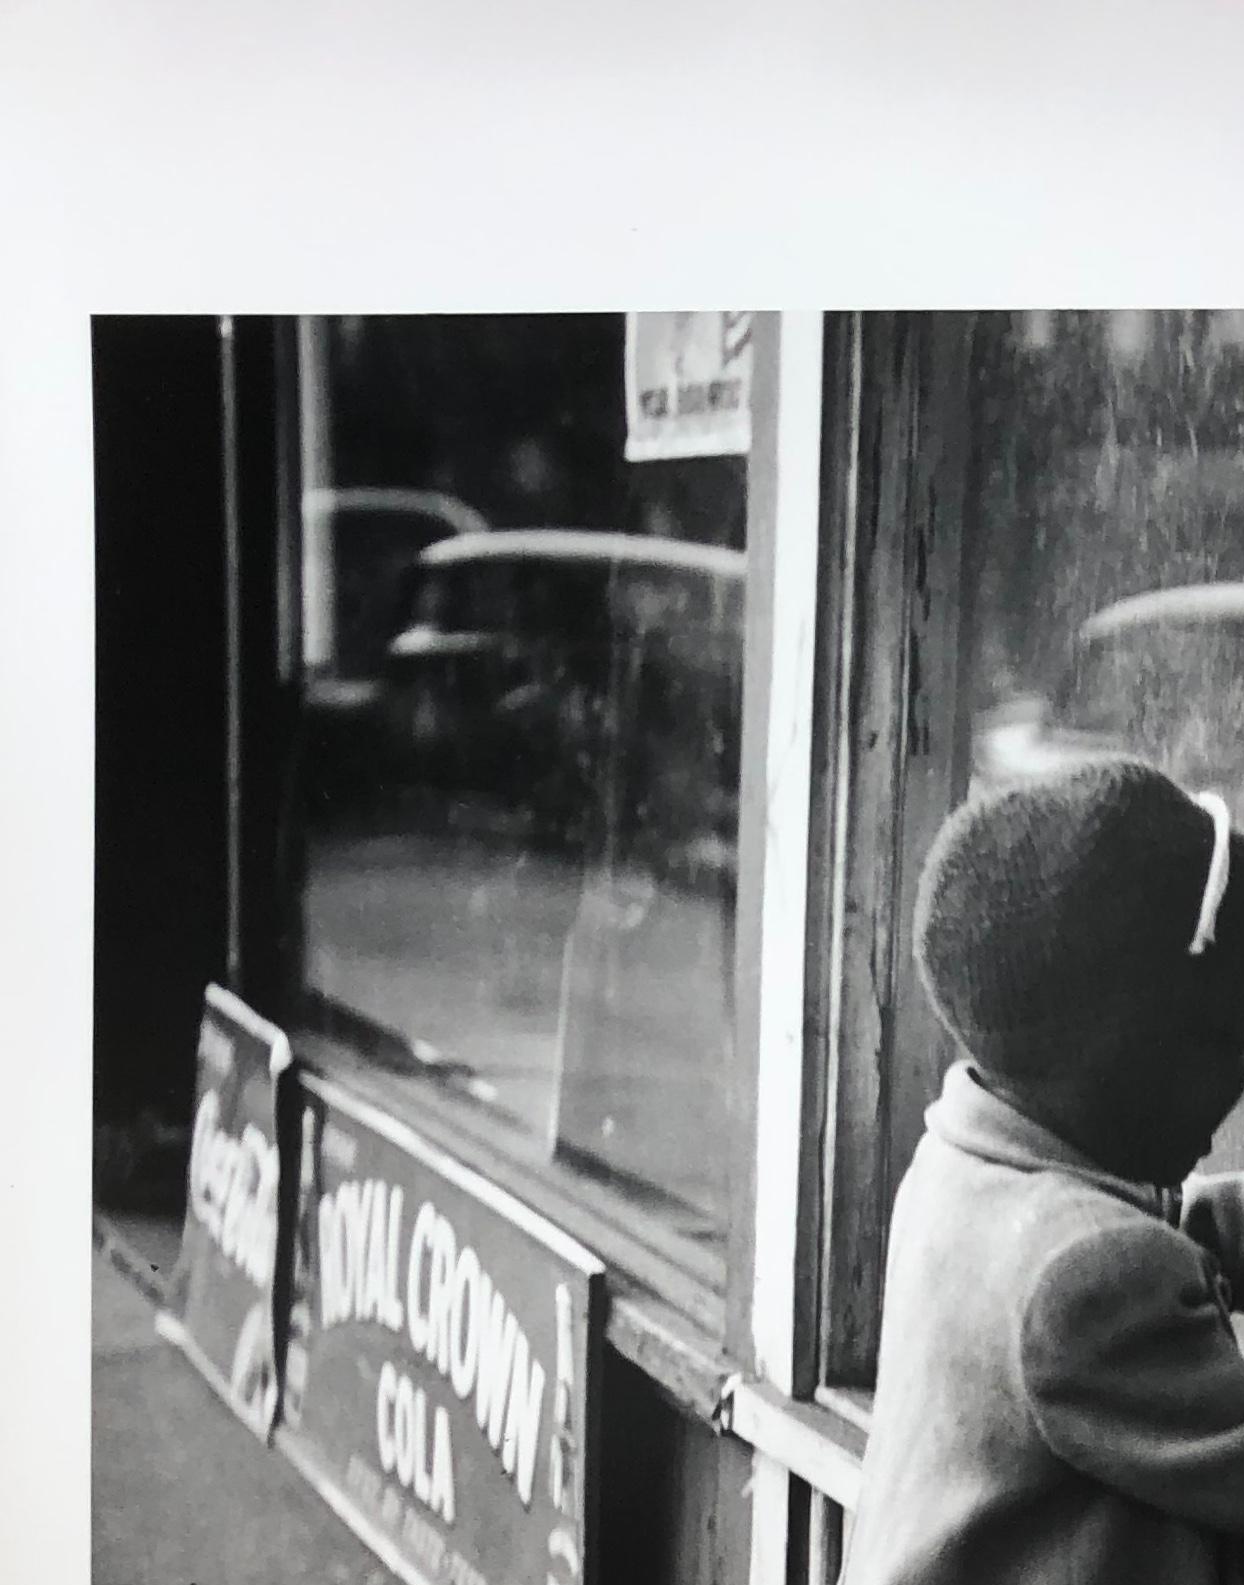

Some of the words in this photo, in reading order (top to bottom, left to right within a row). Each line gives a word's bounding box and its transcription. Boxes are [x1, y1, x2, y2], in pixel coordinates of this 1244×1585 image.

[319, 1177, 404, 1331] ROYAL
[408, 1201, 546, 1504] CROWN
[377, 1360, 455, 1524] COLA
